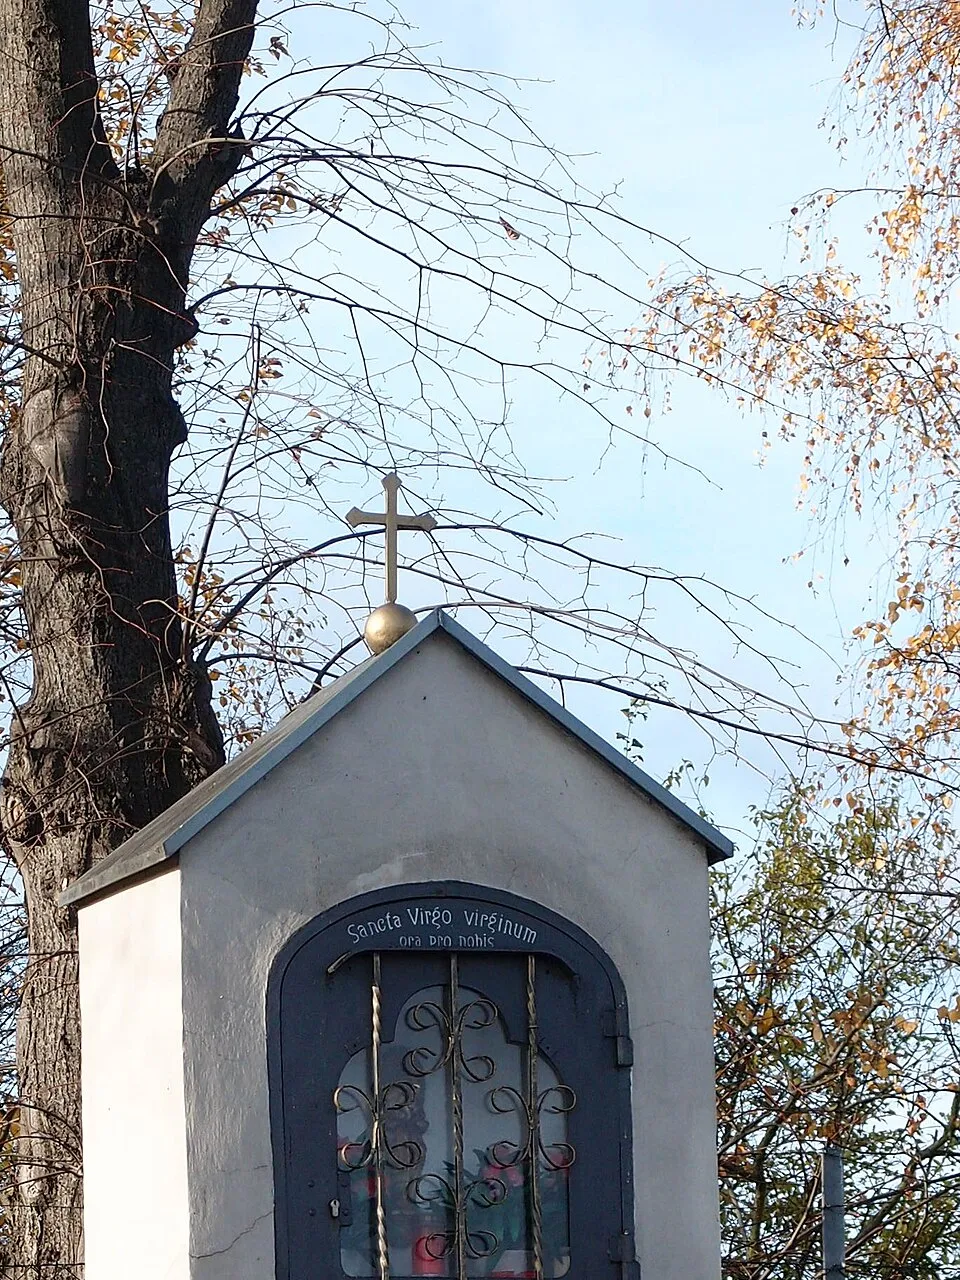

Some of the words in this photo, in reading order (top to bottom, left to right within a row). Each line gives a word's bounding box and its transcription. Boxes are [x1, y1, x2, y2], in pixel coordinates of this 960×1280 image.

[347, 911, 402, 945] Sancta
[406, 906, 452, 930] Virgo
[400, 934, 421, 947] ora
